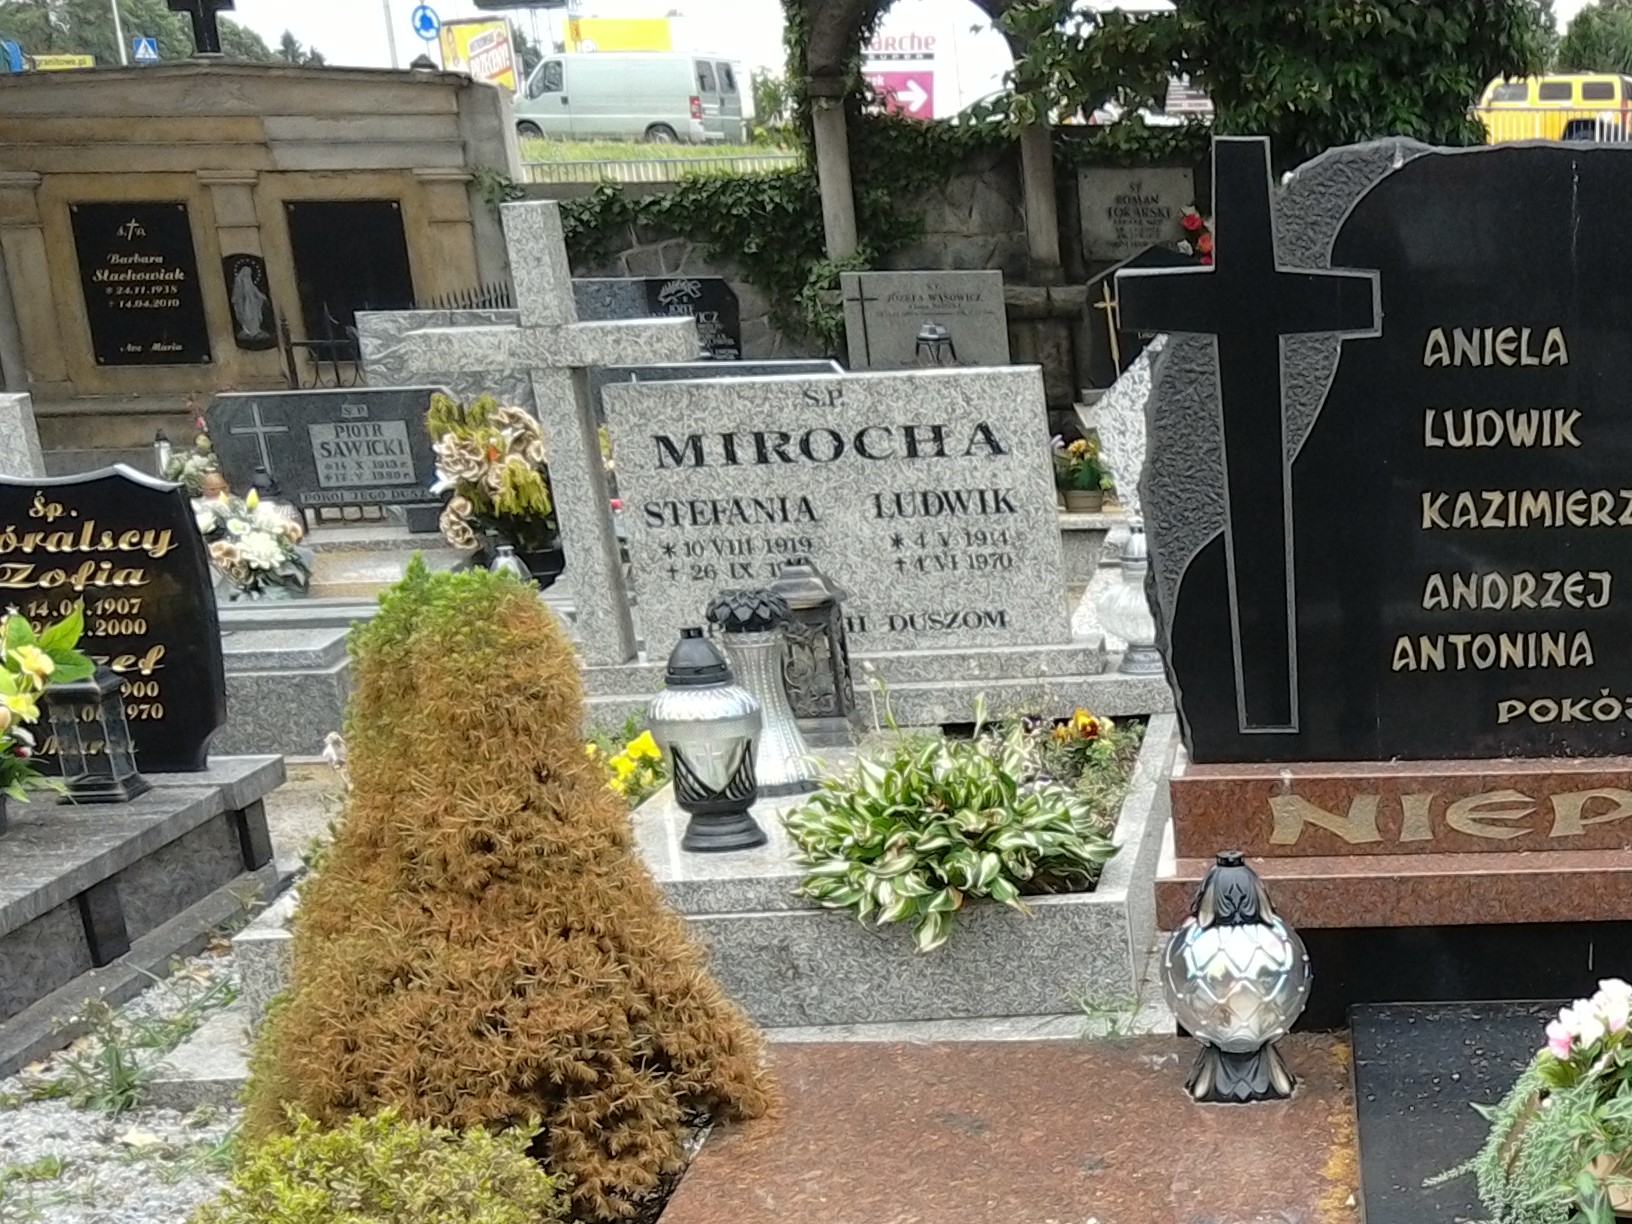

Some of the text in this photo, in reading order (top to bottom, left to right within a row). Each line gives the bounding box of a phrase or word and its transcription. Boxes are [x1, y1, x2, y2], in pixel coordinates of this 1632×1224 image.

[107, 253, 163, 264] Barbara
[92, 268, 185, 281] Stachowiak
[1422, 326, 1570, 367] ANIELA
[334, 423, 384, 439] PIOTR
[1424, 408, 1583, 448] LUDWIK
[320, 438, 405, 458] SAWICKI
[651, 421, 1011, 470] MIROCHA
[643, 495, 820, 529] STEFANIA
[871, 487, 1020, 520] LUDWIK
[0, 520, 179, 559] óralscy
[683, 536, 813, 558] 10 VIII 1919
[691, 563, 718, 581] 26
[729, 562, 755, 579] IX
[967, 552, 1014, 570] 1970
[0, 560, 151, 592] Zofia
[1422, 571, 1613, 610] ANDRZEJ
[28, 598, 142, 617] 14.0.1907
[889, 609, 1007, 631] DUSZOM
[1392, 631, 1595, 672] ANTONINA
